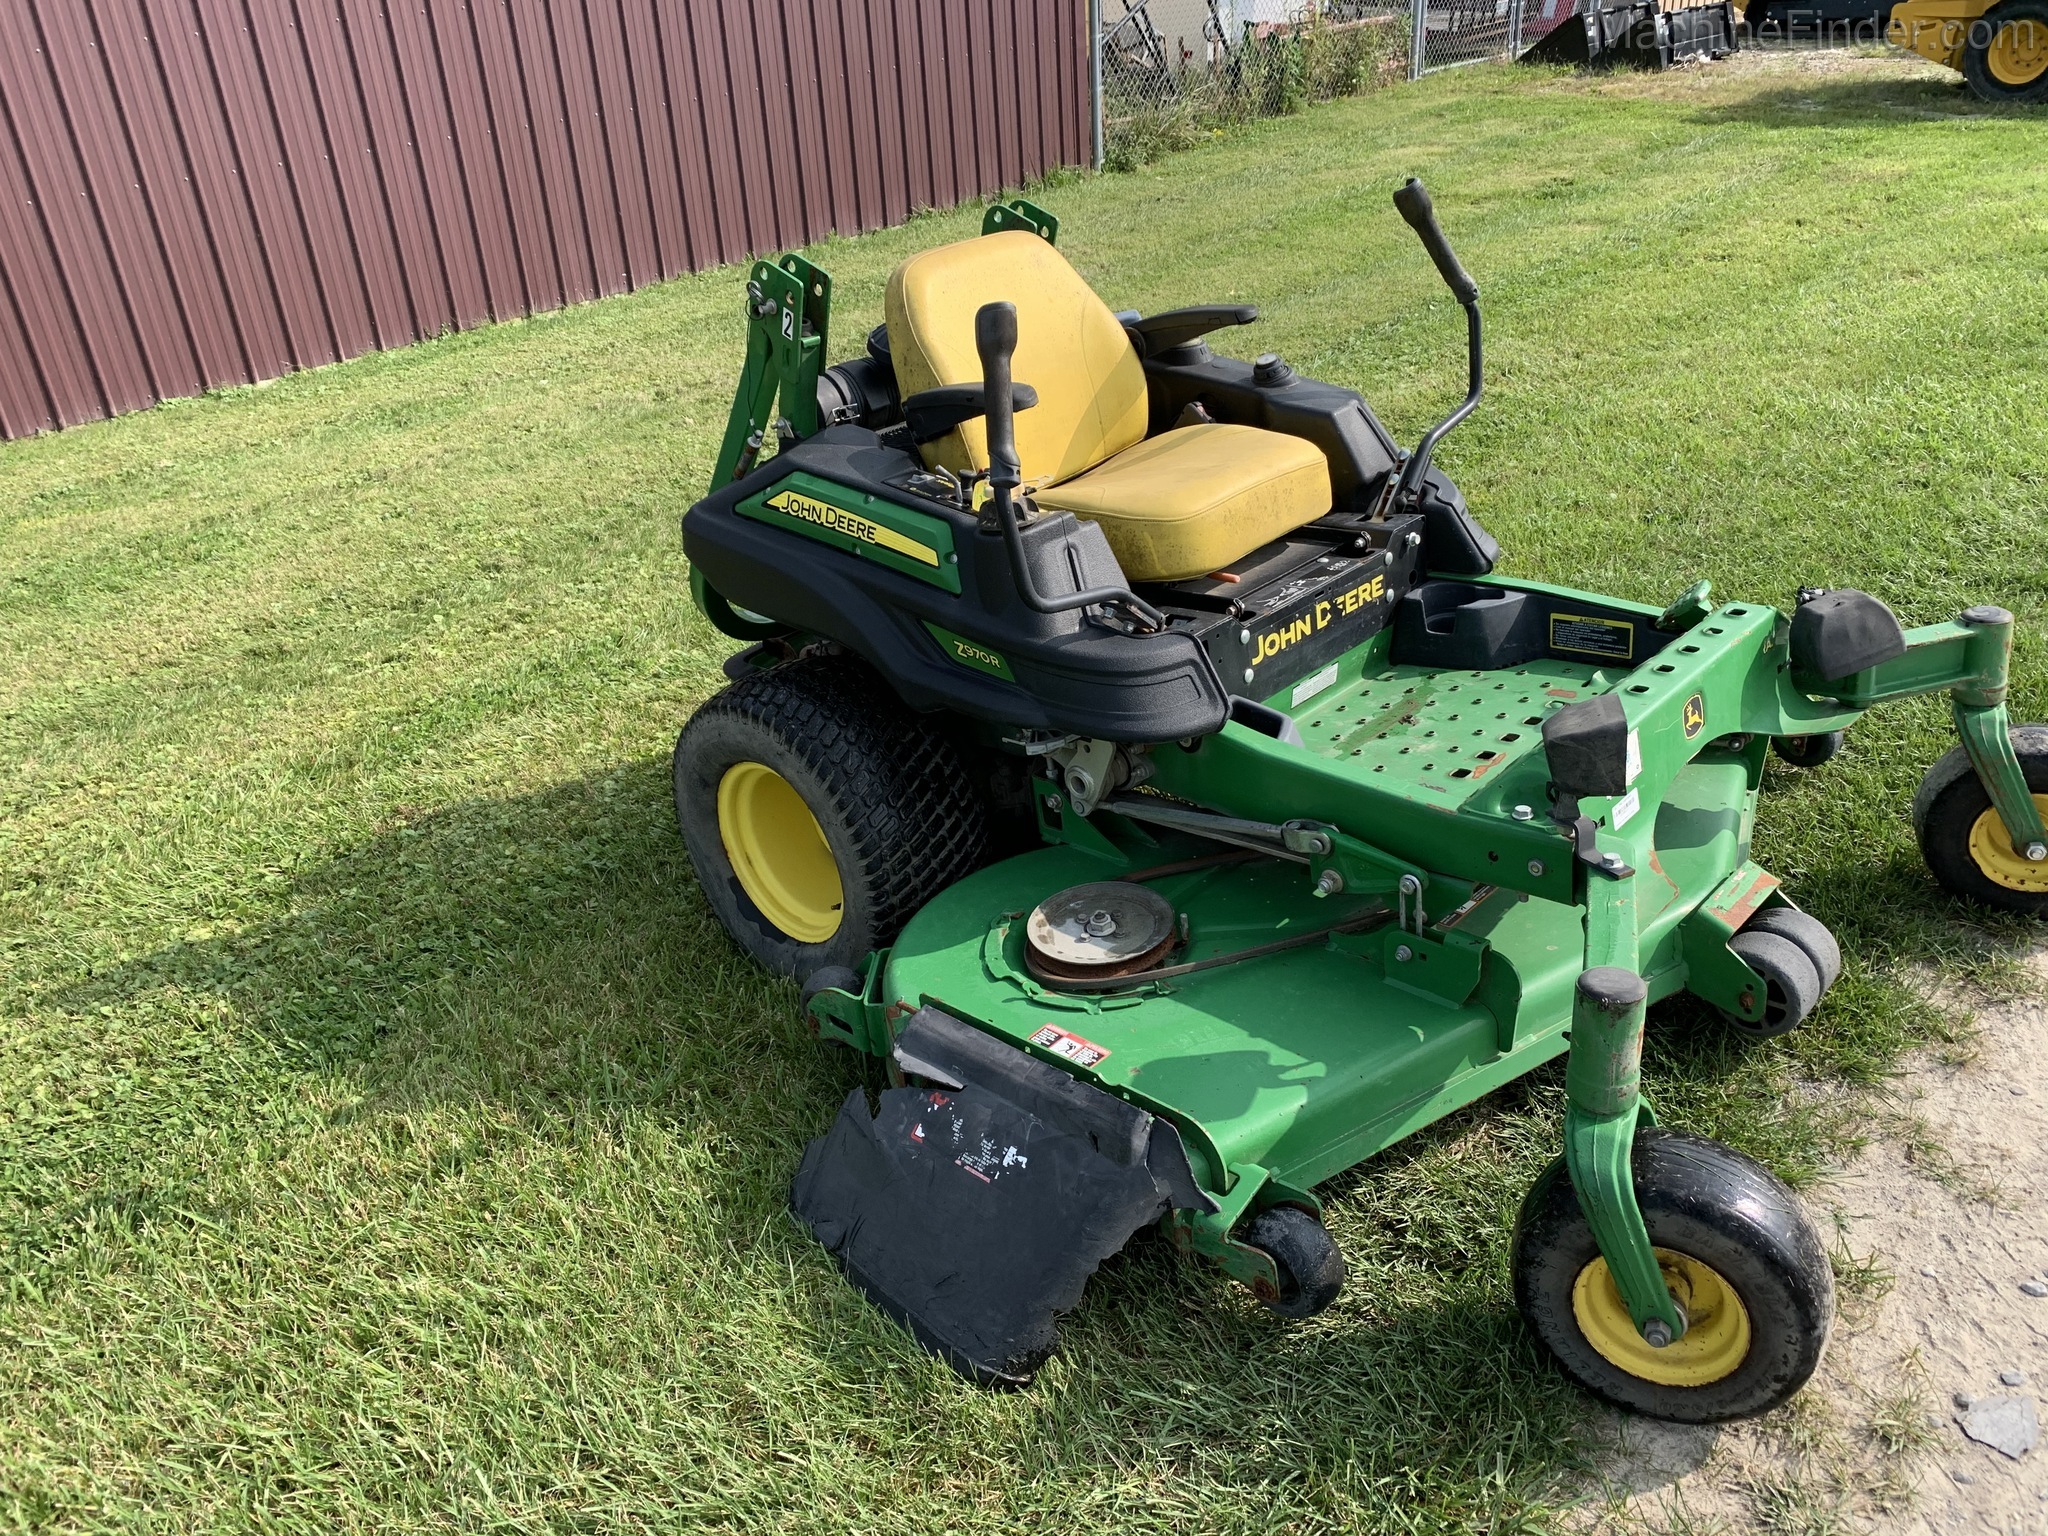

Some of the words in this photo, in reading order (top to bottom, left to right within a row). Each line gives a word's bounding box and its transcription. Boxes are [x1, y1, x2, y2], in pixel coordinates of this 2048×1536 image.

[784, 312, 792, 338] 2
[781, 494, 822, 522] JOHN
[825, 506, 877, 541] DEERE
[953, 640, 1001, 668] Z970R
[1251, 614, 1312, 666] JOHN
